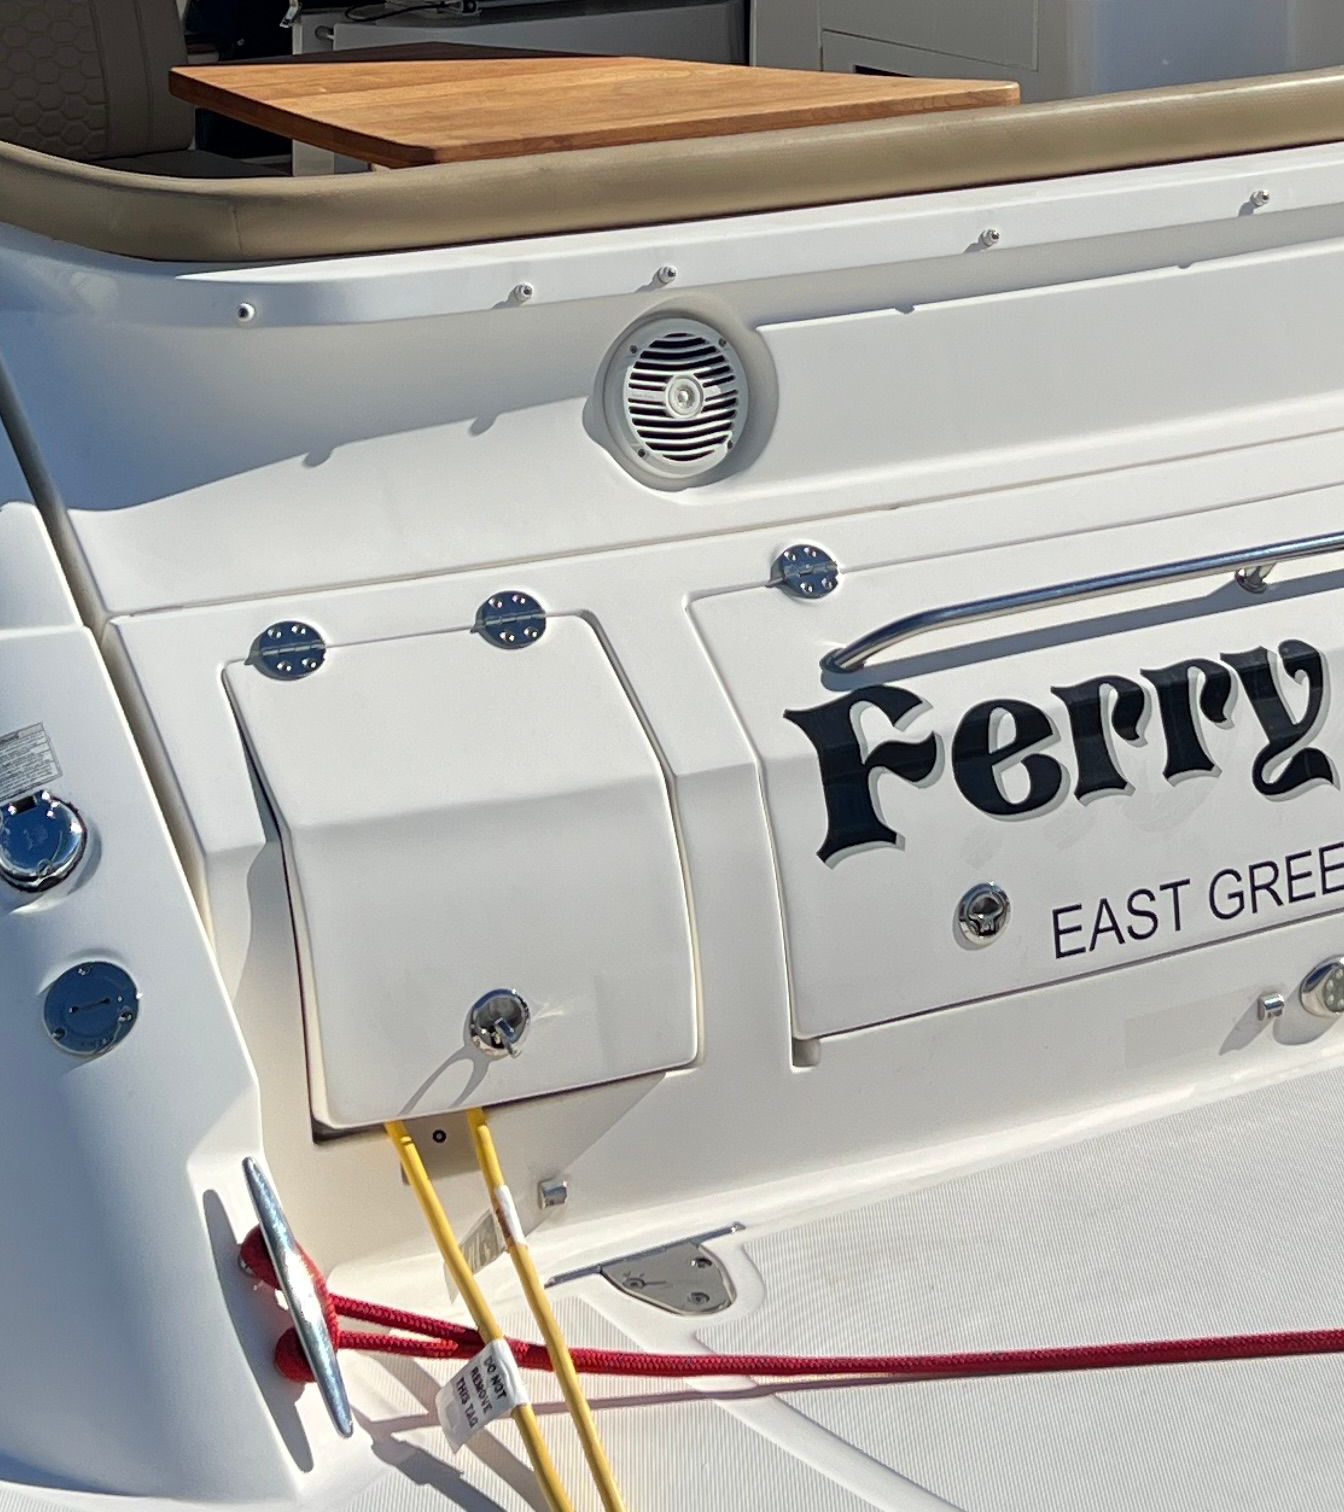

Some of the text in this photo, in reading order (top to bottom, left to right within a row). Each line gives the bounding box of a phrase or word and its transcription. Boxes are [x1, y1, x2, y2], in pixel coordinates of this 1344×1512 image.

[784, 638, 1340, 868] Ferry
[1052, 879, 1191, 959] EAST
[456, 1376, 471, 1405] THIS
[471, 1365, 493, 1414] REMOVE
[484, 1355, 507, 1400] DO NOT
